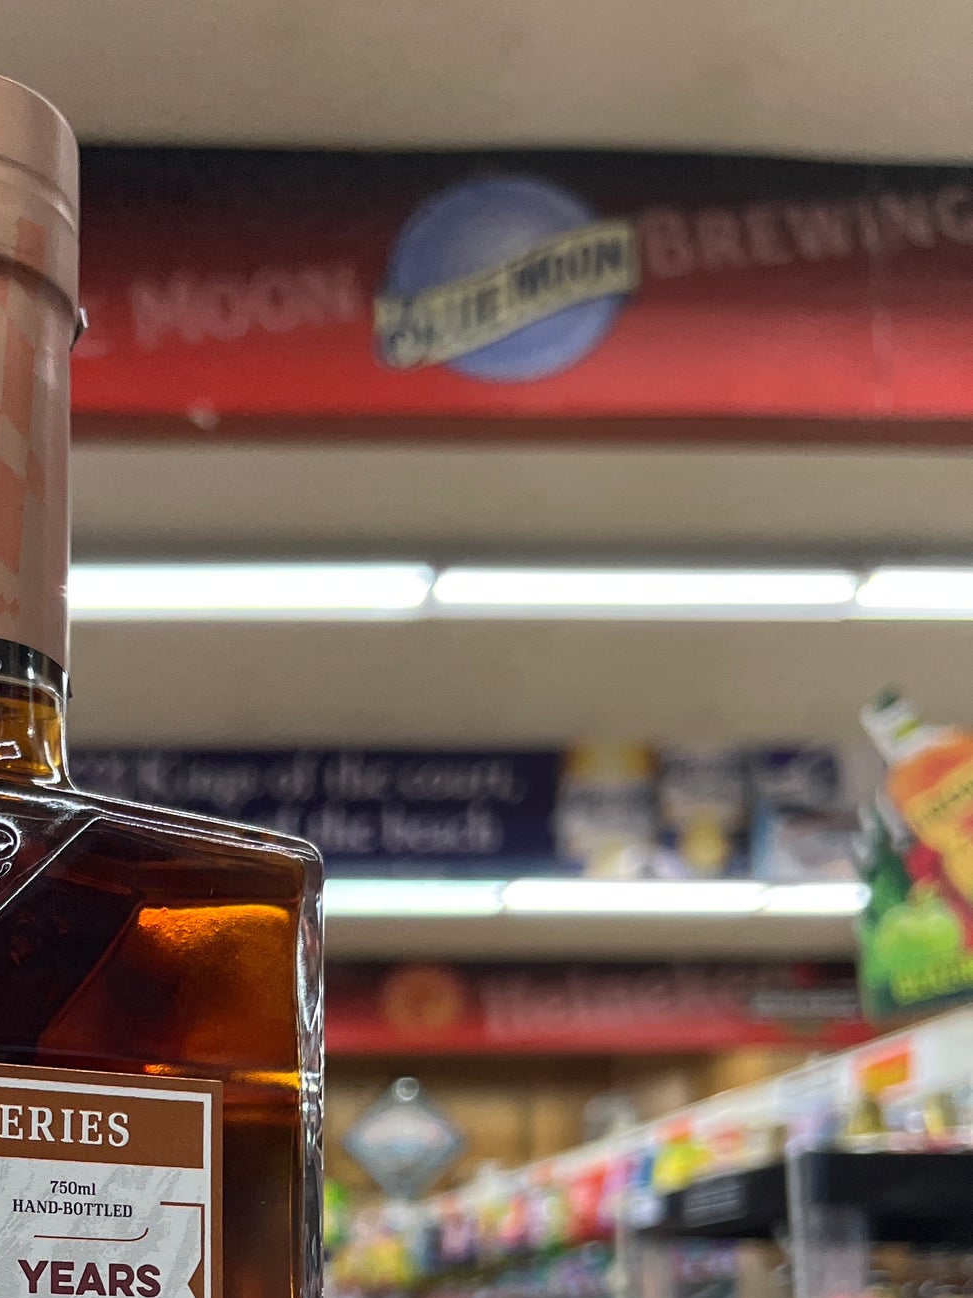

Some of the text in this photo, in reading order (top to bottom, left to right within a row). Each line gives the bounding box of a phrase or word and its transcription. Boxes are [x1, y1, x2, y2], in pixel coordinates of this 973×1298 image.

[49, 1180, 97, 1196] 750ml
[12, 1198, 134, 1218] HAND-BOTTLED
[17, 1259, 162, 1298] YEARS
